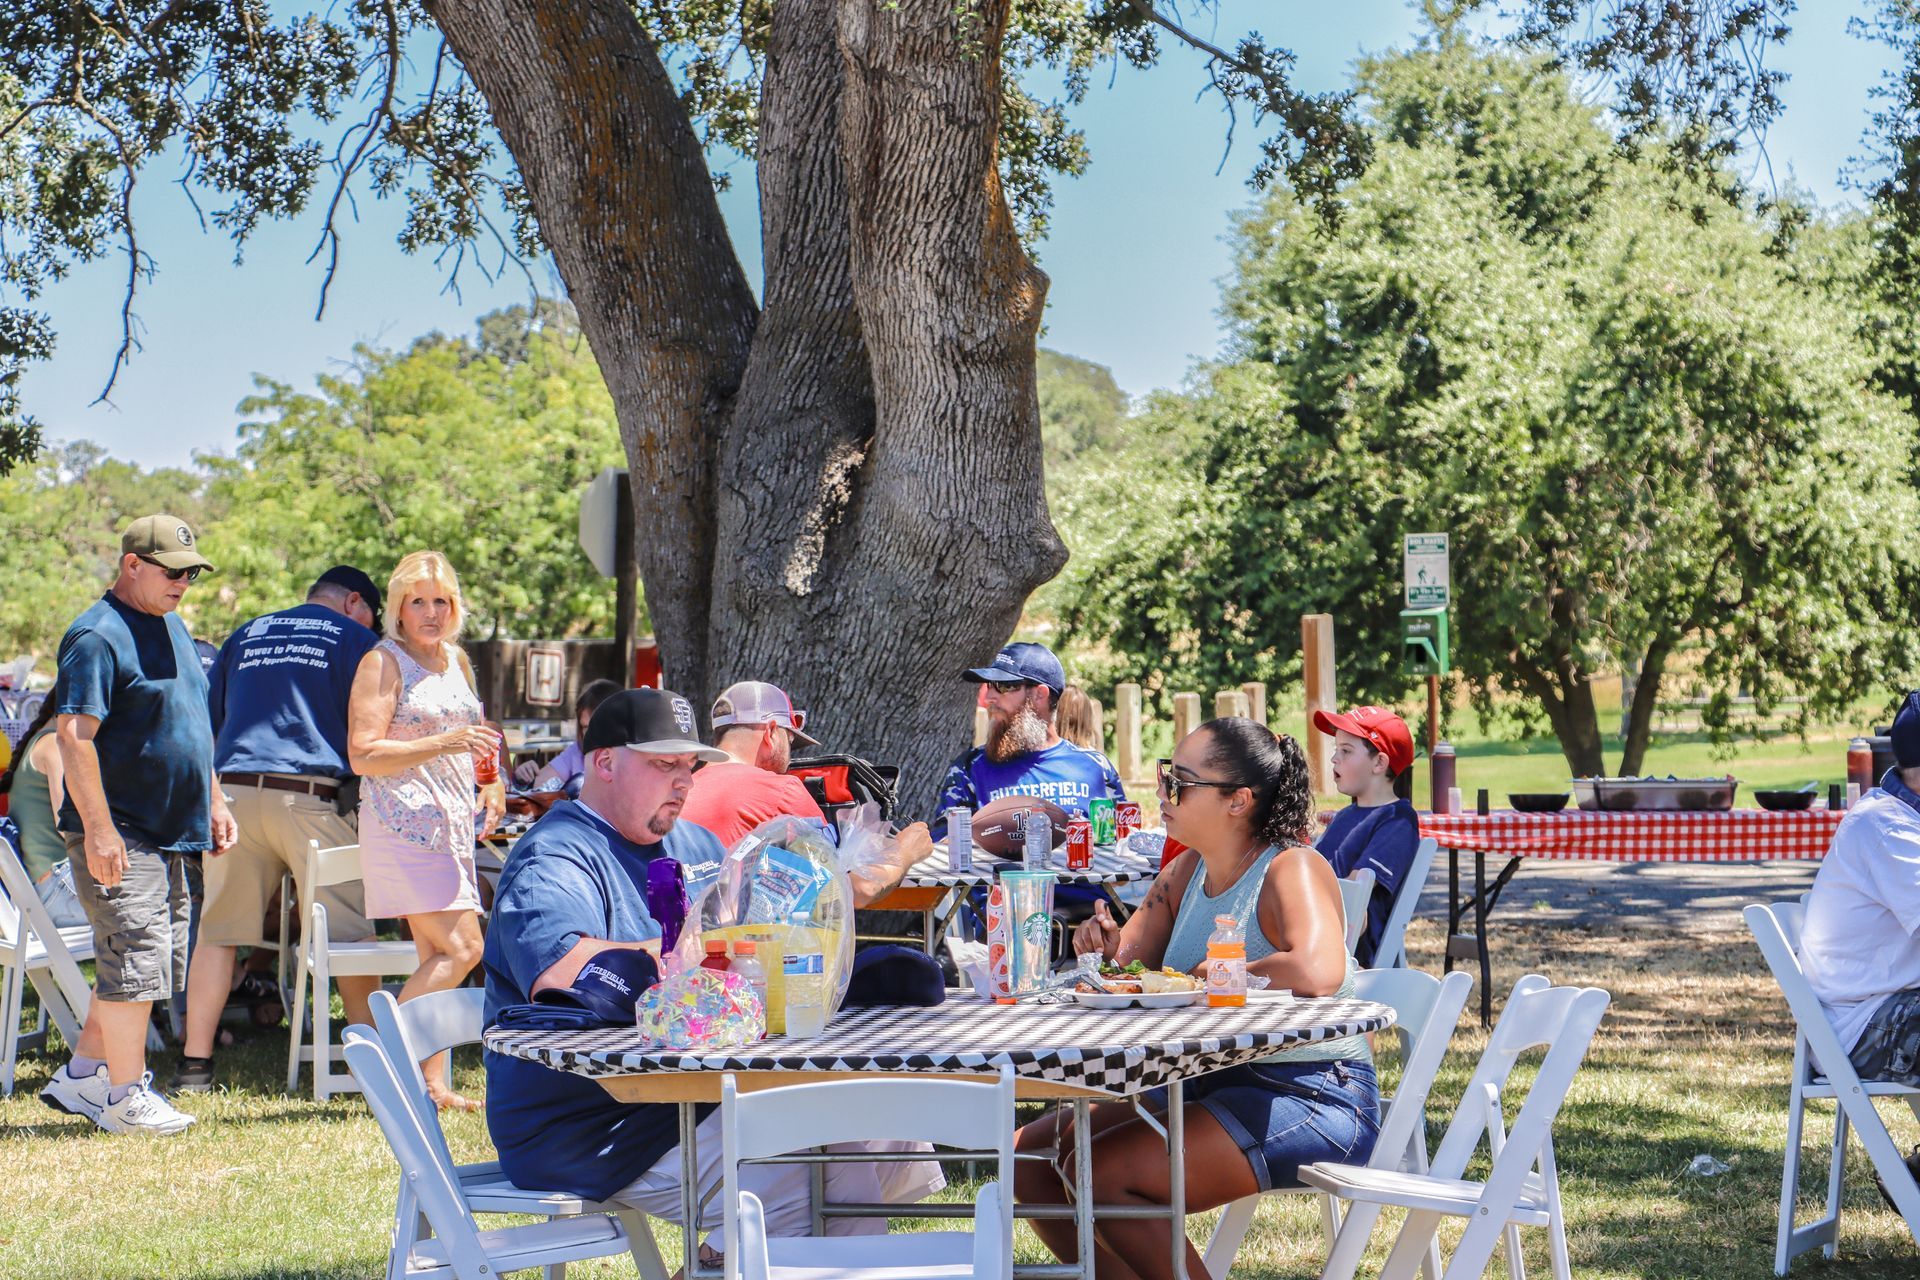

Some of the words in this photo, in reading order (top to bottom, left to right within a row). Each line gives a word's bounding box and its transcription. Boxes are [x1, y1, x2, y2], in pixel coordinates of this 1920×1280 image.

[244, 646, 273, 659] Power
[274, 645, 285, 655] to
[285, 643, 326, 658] Perform
[238, 659, 262, 670] Family
[262, 655, 309, 666] Appreciation
[989, 781, 1090, 802] BUTTERFIELD
[1059, 797, 1078, 806] INC
